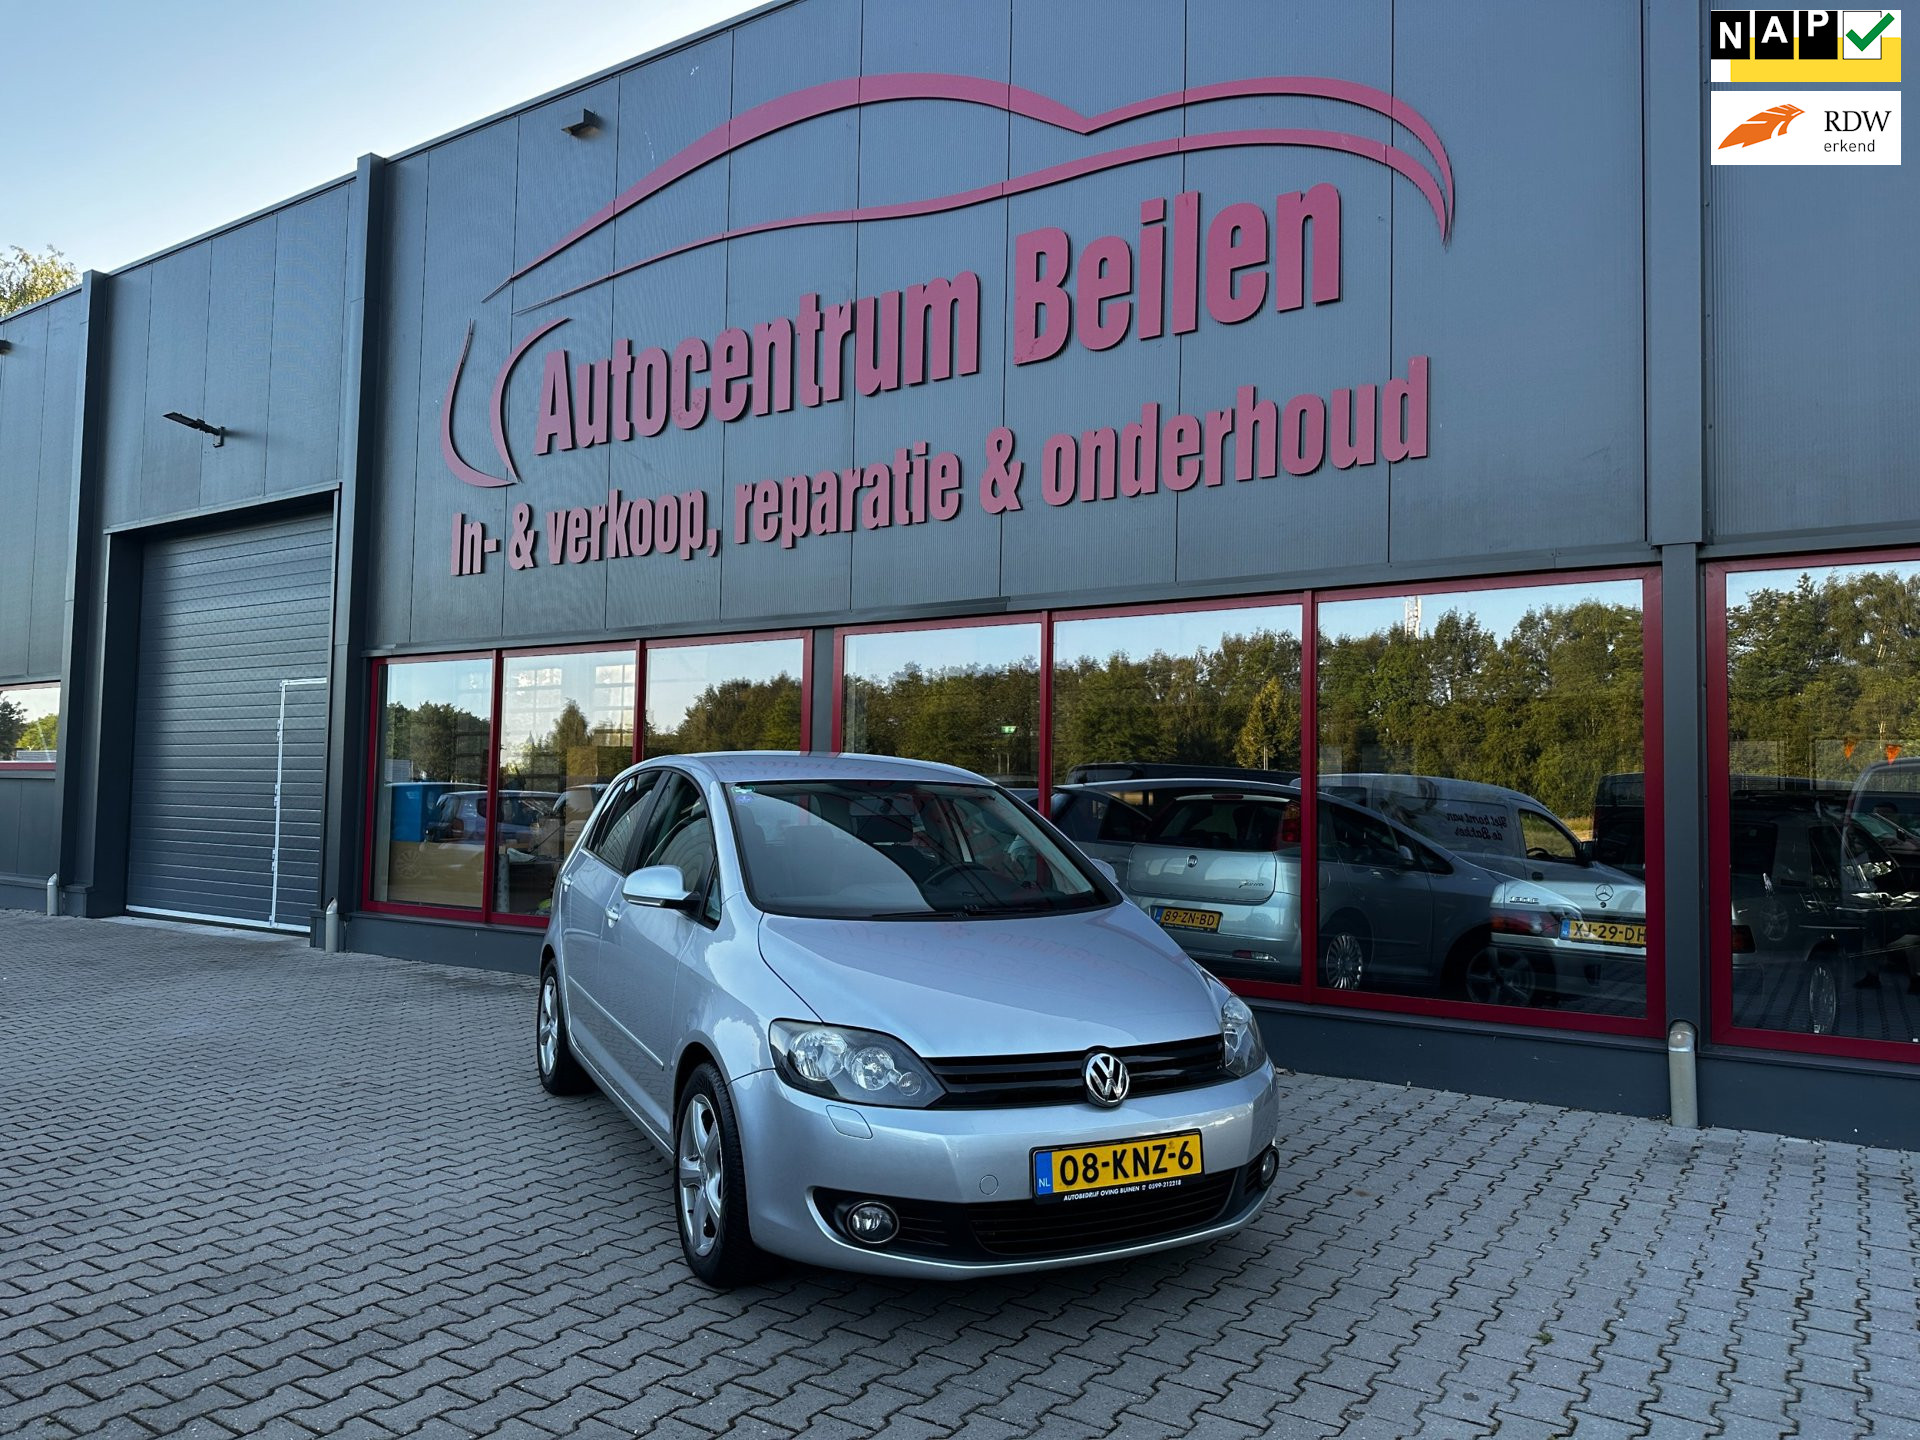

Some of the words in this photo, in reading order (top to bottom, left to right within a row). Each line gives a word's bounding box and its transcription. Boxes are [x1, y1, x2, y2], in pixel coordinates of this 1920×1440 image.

[535, 270, 981, 456] Autocentrum
[1013, 182, 1342, 366] Beilen
[450, 512, 499, 576] In-
[508, 502, 536, 571] &
[546, 489, 720, 561] verkoop,
[734, 441, 961, 550] reparatie
[980, 426, 1023, 515] &
[1041, 355, 1431, 507] onderhoud
[1164, 910, 1215, 926] 89-ZN-BD
[1059, 1140, 1194, 1187] 08-KNZ-6
[1038, 1177, 1051, 1188] NL
[1063, 1190, 1099, 1201] AUTOBEDRIJF
[1100, 1188, 1119, 1197] OVING
